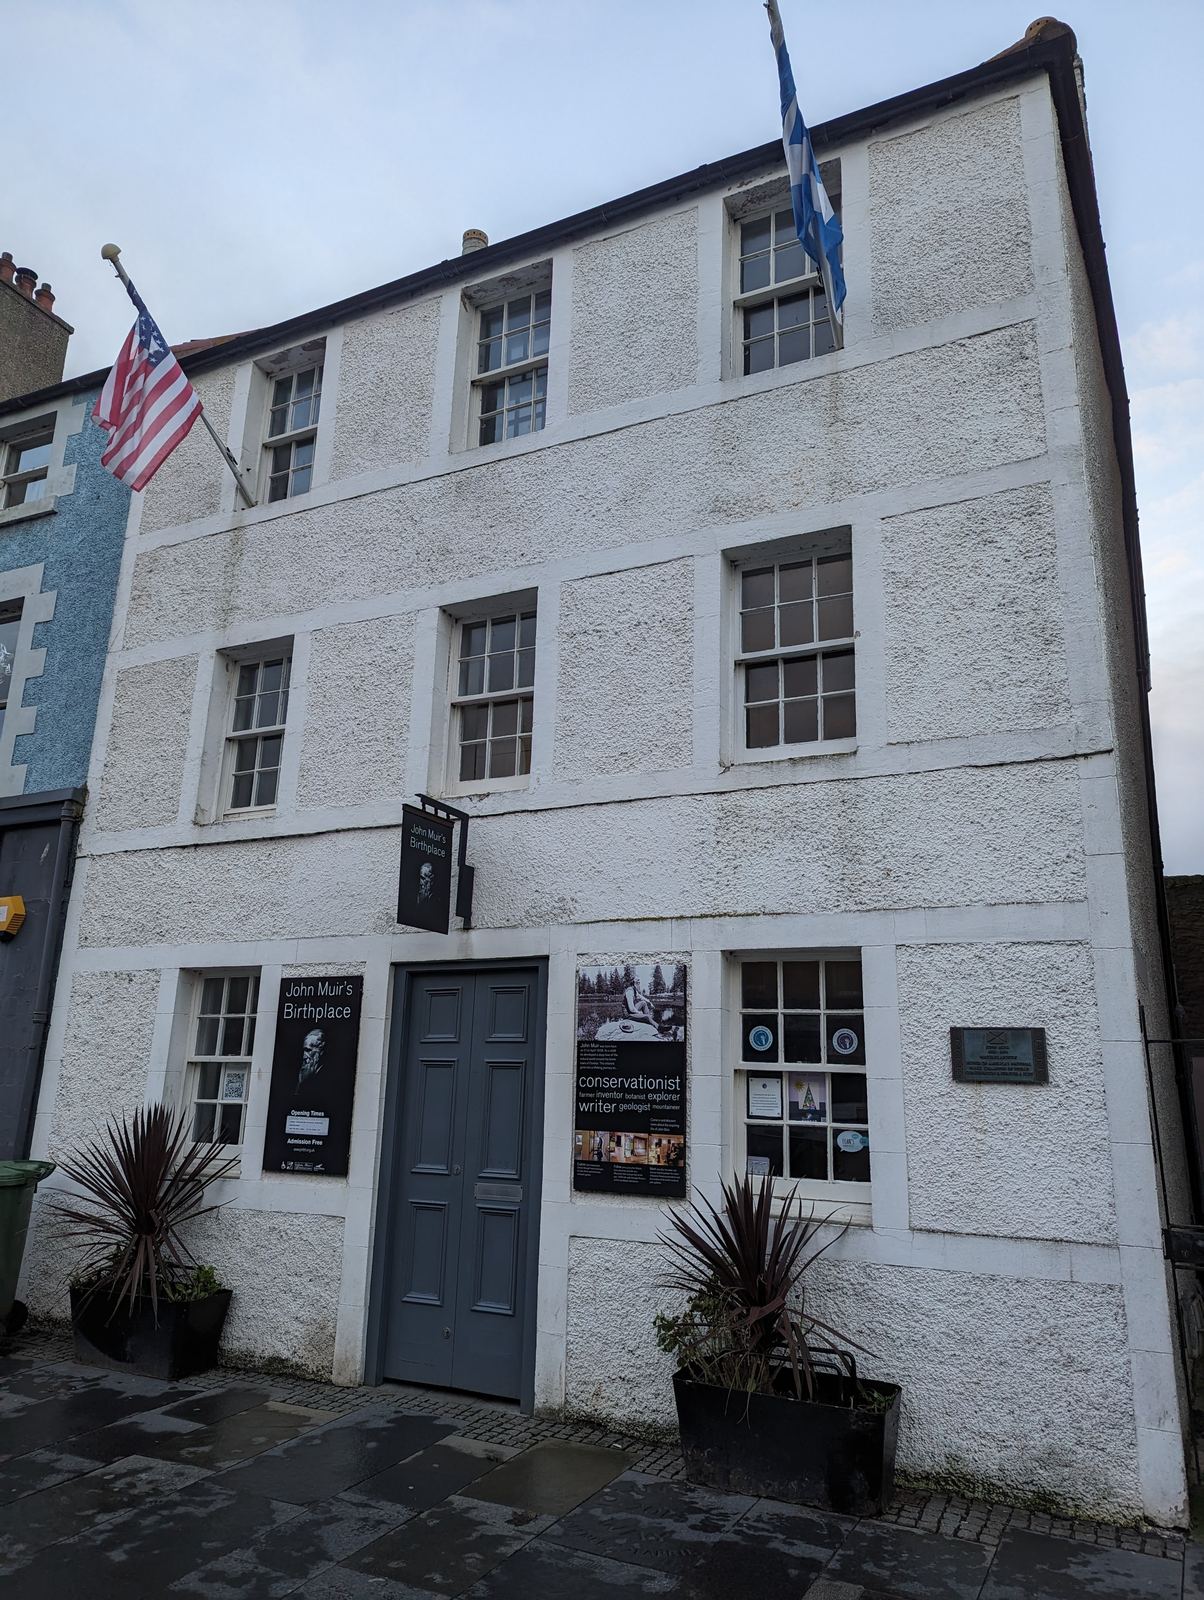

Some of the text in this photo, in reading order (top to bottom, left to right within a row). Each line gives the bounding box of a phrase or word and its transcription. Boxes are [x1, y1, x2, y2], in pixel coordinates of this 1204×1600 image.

[411, 823, 446, 844] John Muir's
[410, 836, 446, 858] Birthplace
[286, 981, 353, 998] John Muir's
[283, 1002, 351, 1023] Birthplace
[579, 1075, 681, 1091] conservationist
[596, 1090, 624, 1099] inventor
[625, 1092, 646, 1100] botanist
[647, 1091, 680, 1103] explorer
[290, 1109, 311, 1117] Opening
[578, 1099, 617, 1113] writer
[618, 1102, 651, 1113] geologist
[286, 1137, 312, 1145] Admission
